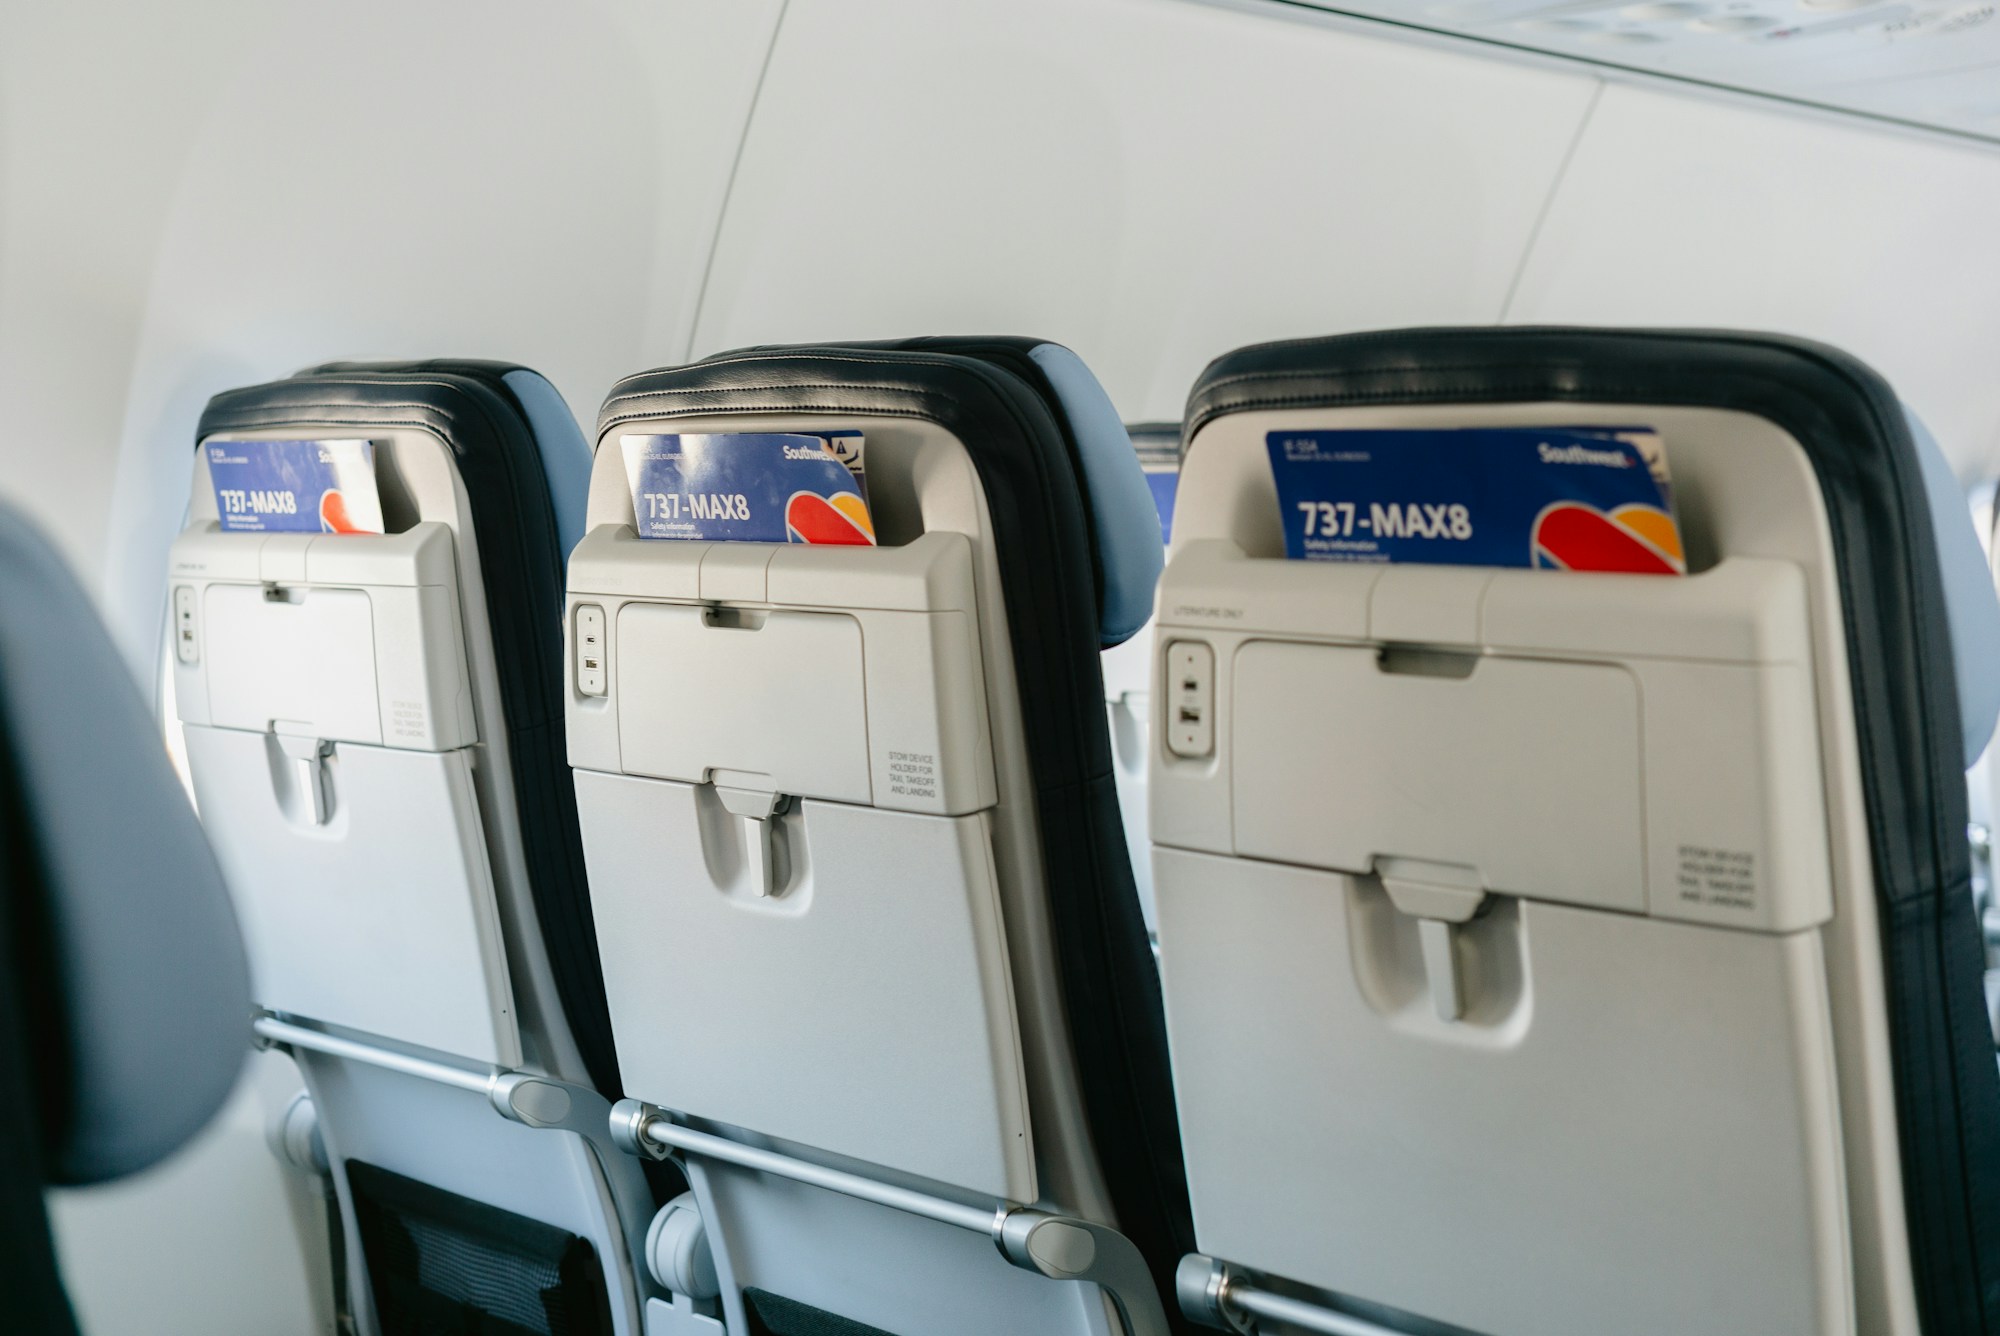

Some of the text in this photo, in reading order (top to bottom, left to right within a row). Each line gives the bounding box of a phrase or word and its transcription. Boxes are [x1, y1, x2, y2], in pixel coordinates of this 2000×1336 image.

[1537, 442, 1628, 469] Southwest
[220, 489, 297, 514] 737-MAX8
[643, 493, 751, 520] 737-MAX8
[650, 522, 696, 531] Safety information
[1298, 502, 1472, 540] 737-MAX8
[889, 751, 933, 764] STOW DEVICE
[890, 763, 933, 775] HOLDER FOR
[891, 785, 936, 798] AND LANDING
